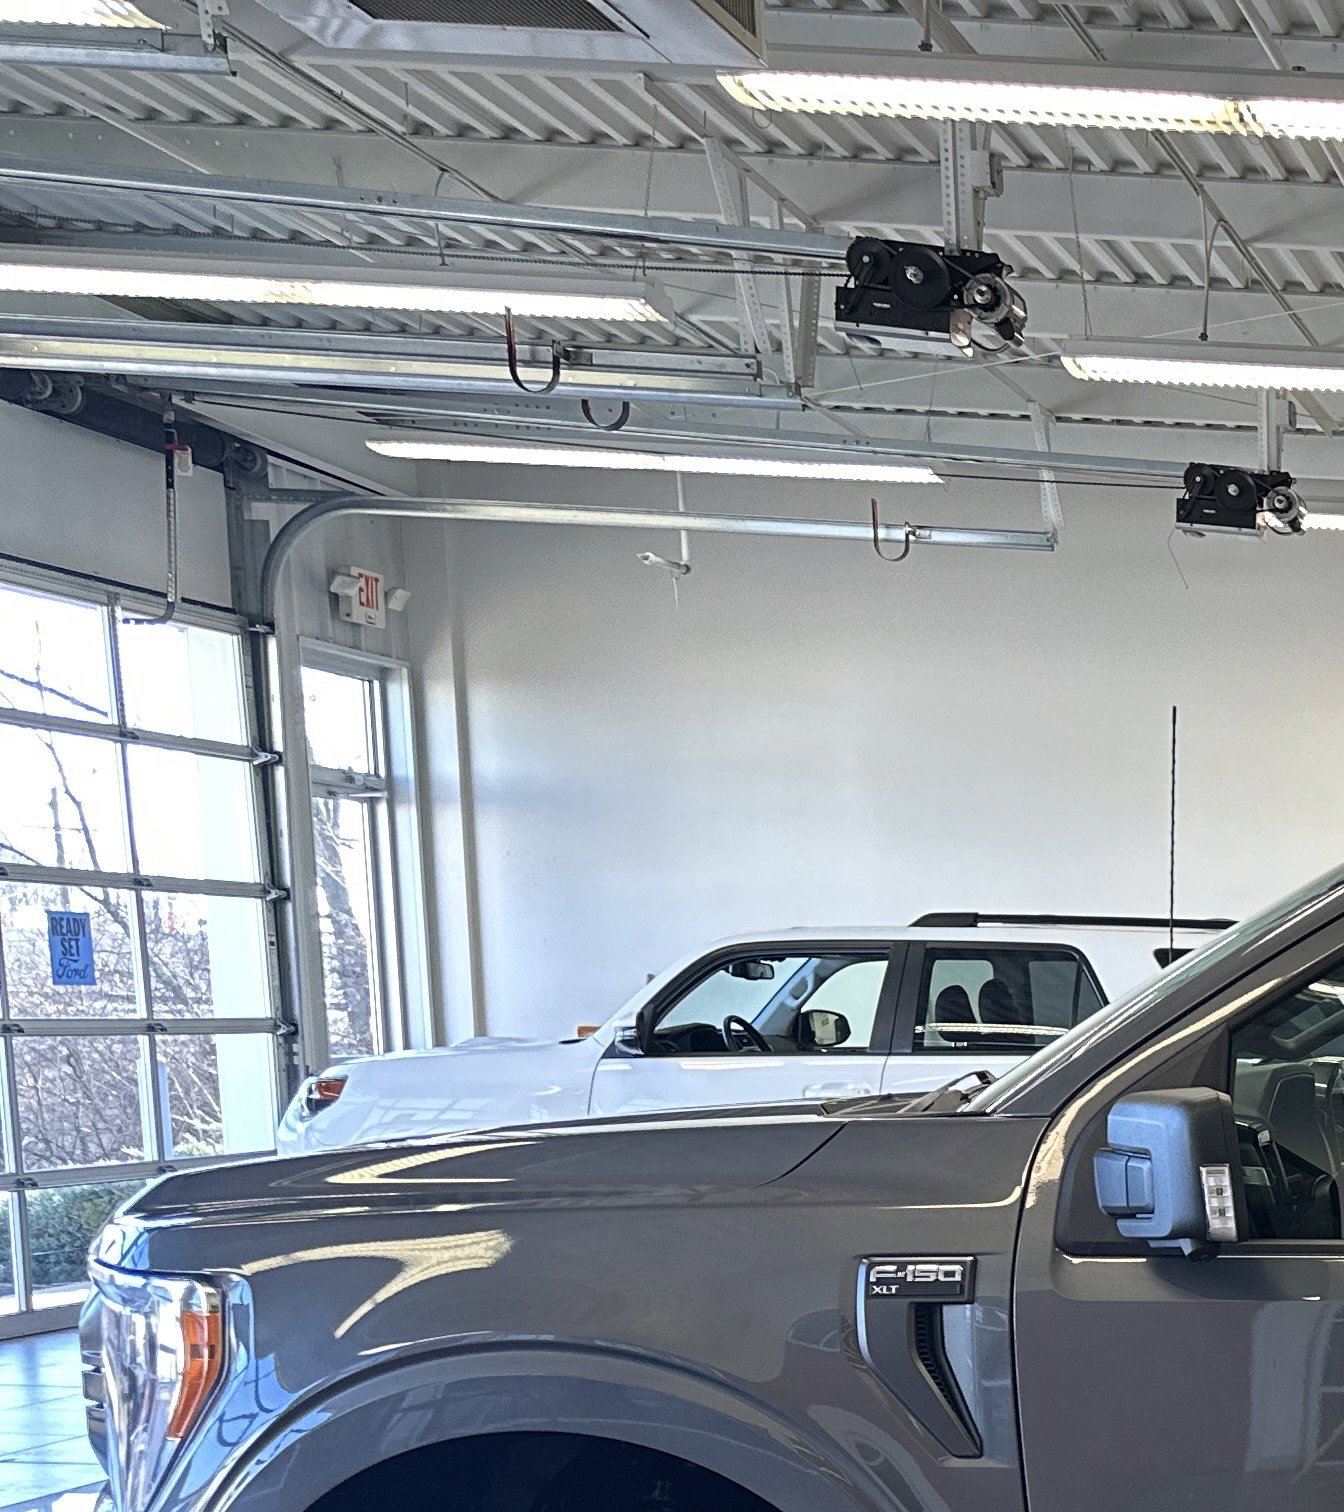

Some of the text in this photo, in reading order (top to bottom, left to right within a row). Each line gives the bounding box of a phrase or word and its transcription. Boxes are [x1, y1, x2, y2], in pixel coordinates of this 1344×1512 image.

[358, 572, 380, 611] EXIT
[50, 916, 87, 938] READY
[60, 937, 80, 957] SET
[55, 957, 90, 980] Ford
[869, 1264, 964, 1282] F-150
[871, 1285, 899, 1295] XLT
